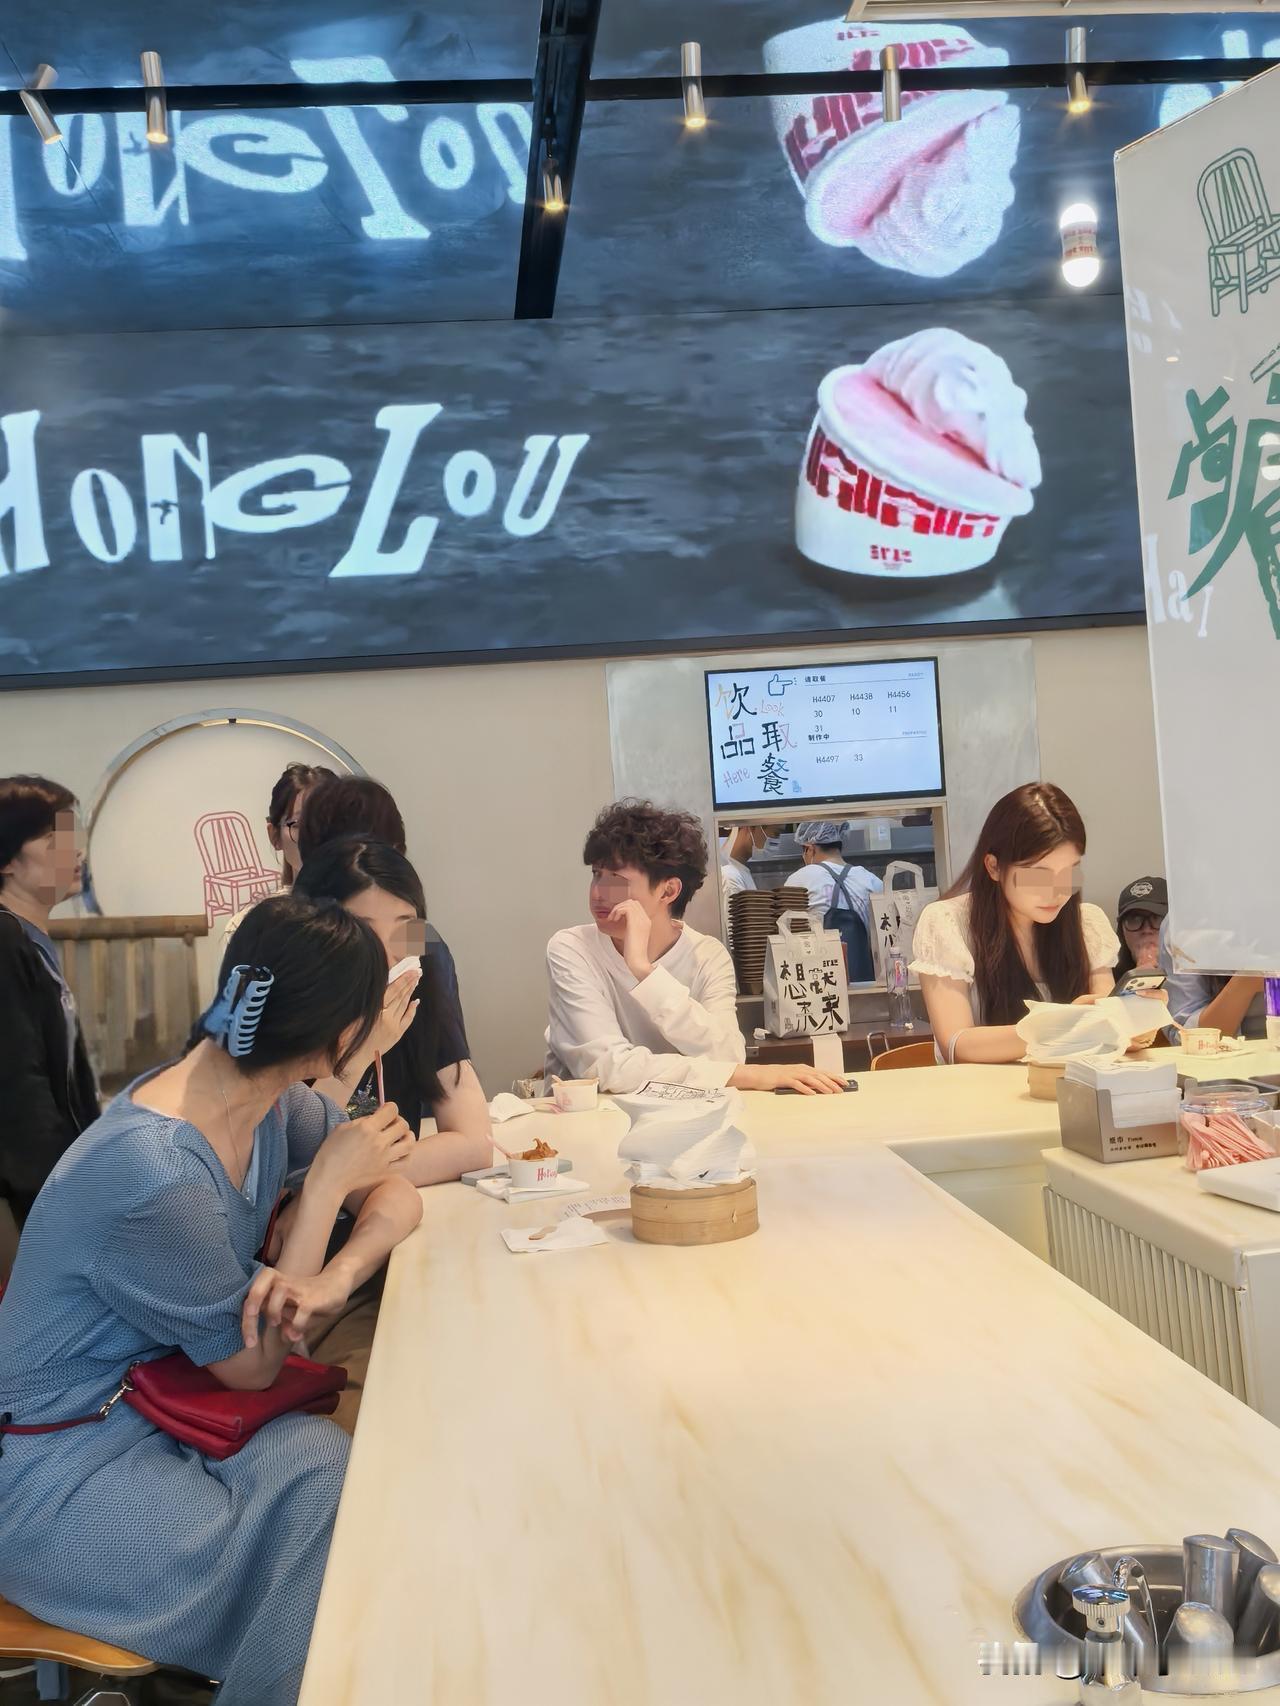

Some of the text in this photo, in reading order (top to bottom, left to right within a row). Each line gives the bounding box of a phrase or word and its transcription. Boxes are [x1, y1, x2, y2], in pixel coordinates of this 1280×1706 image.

[812, 695, 836, 703] H4407
[887, 690, 911, 699] H4456
[814, 705, 897, 718] 30 10 11
